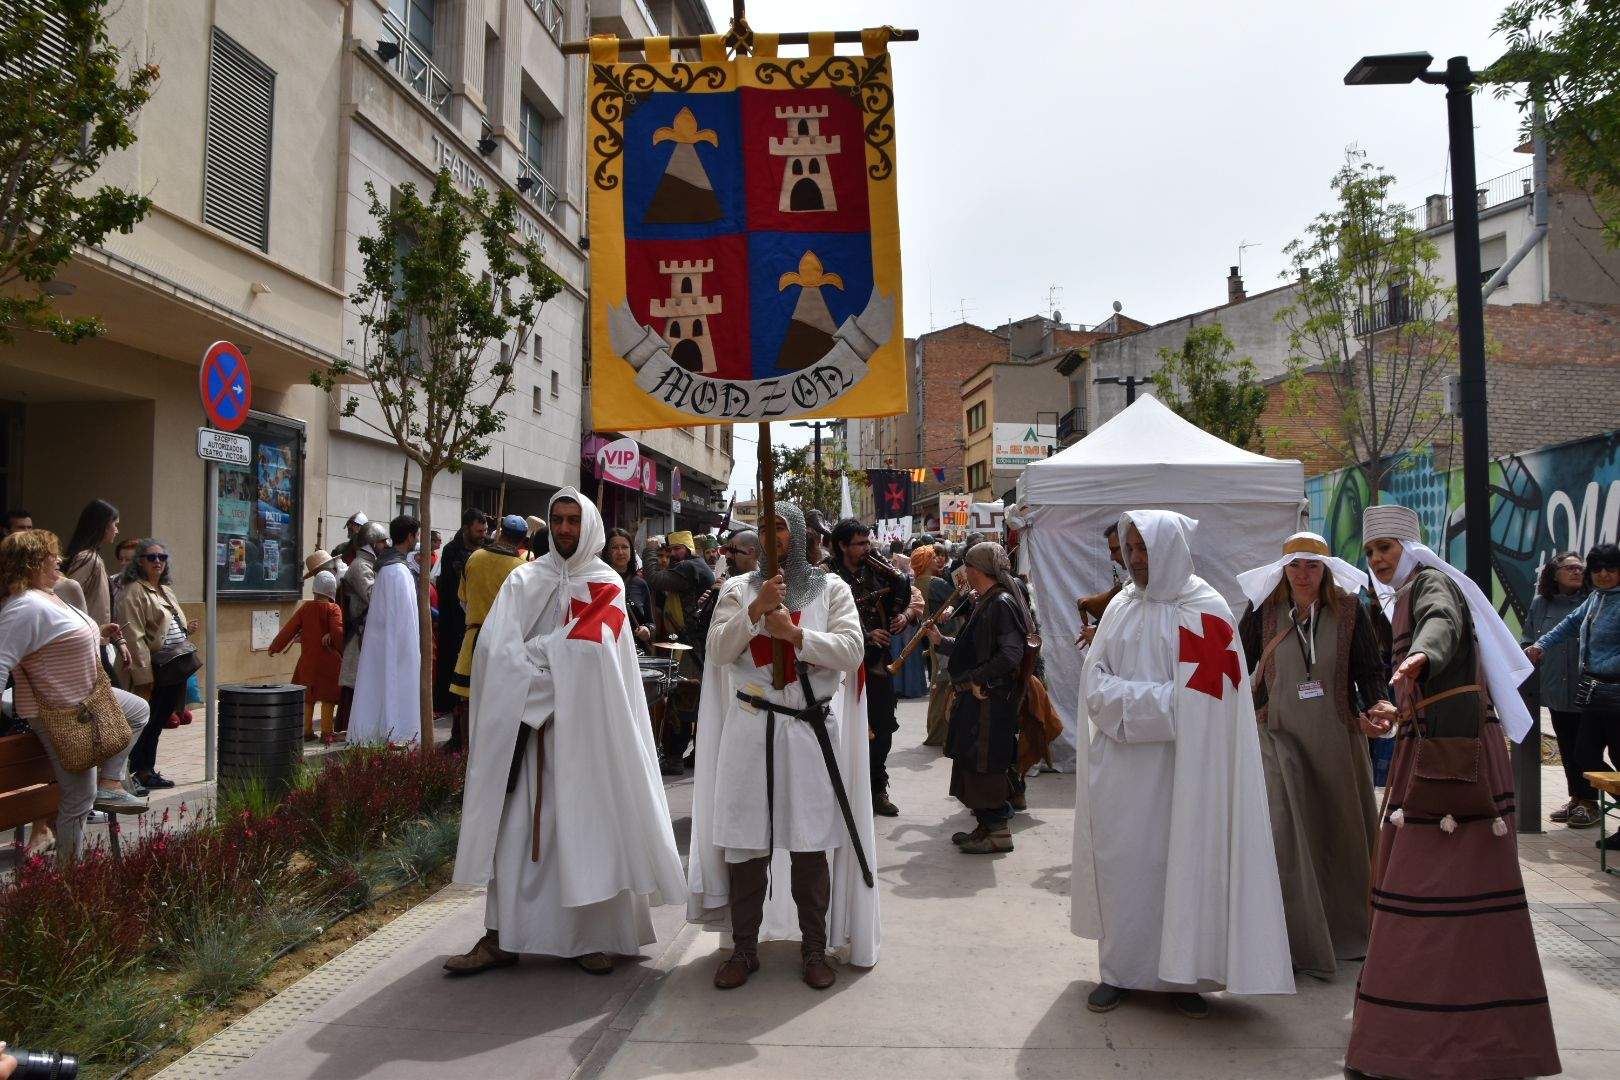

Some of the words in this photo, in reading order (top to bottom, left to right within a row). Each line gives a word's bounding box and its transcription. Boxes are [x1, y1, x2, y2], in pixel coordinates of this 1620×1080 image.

[214, 434, 237, 445] EXCEPTO
[207, 441, 243, 453] AUTORIZADOS
[202, 447, 223, 458] TEATRO
[225, 450, 248, 462] VICTORIA
[604, 449, 635, 466] VIP
